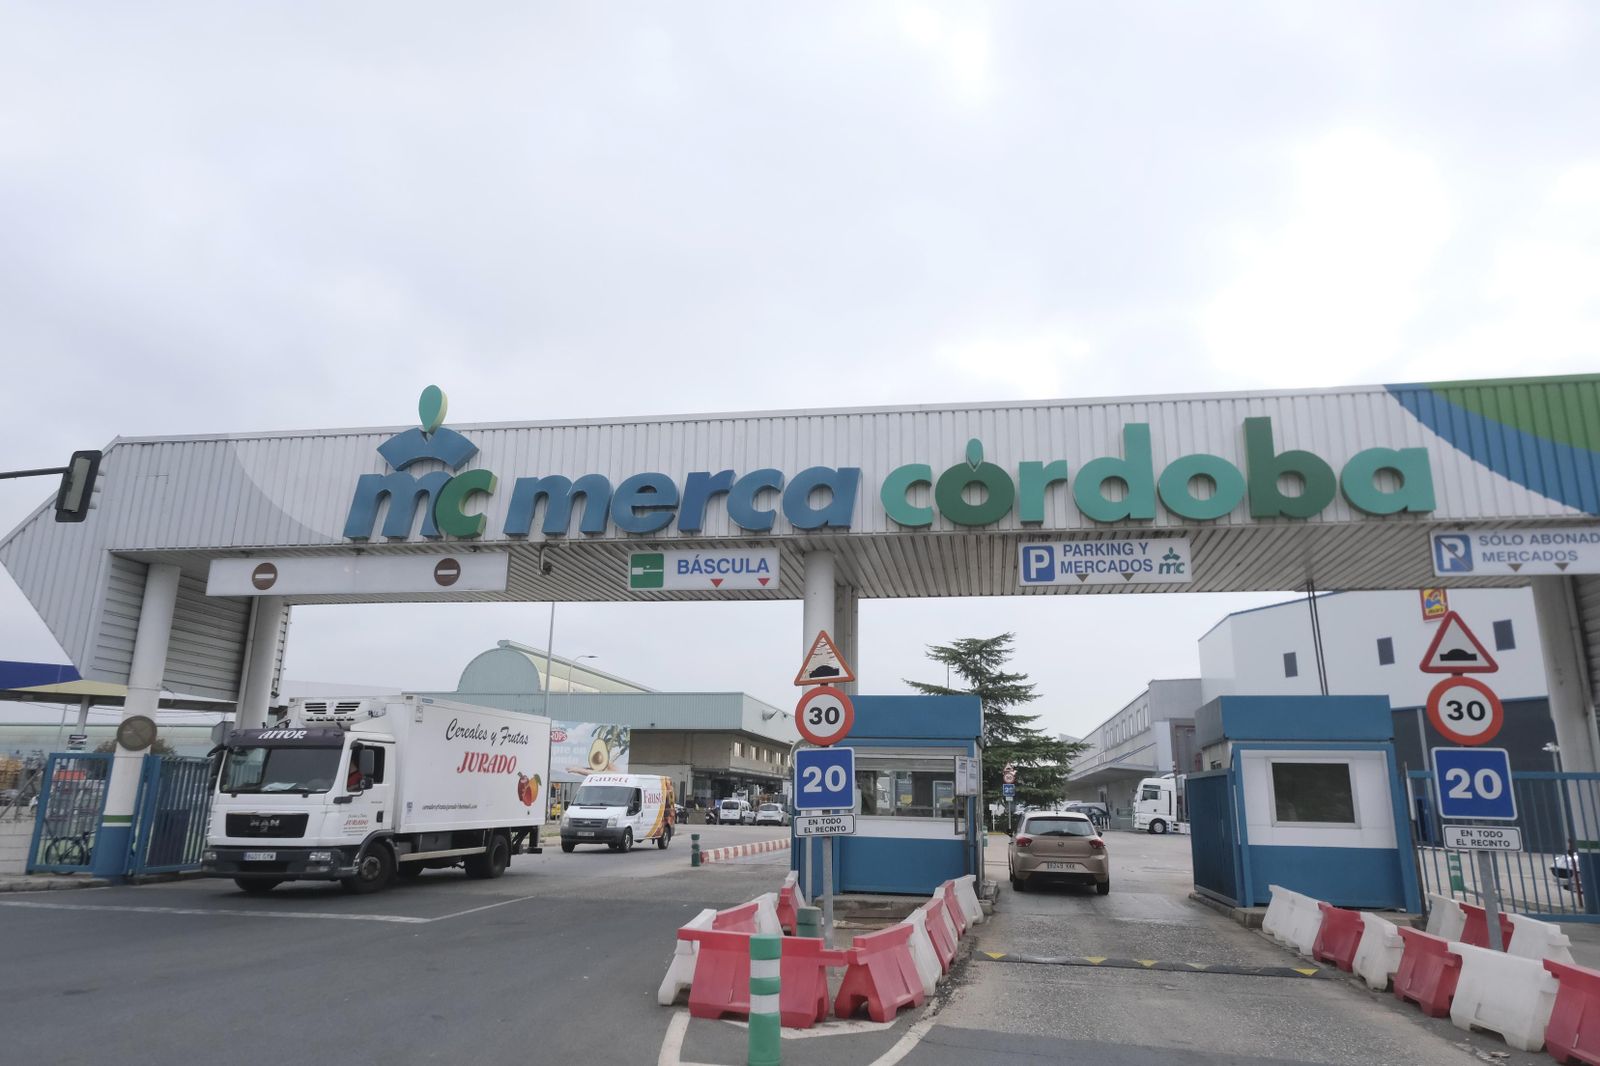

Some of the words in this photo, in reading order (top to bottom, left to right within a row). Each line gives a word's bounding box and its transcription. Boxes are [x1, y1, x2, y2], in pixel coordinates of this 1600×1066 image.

[1478, 531, 1524, 546] SÓLO
[1063, 542, 1134, 557] PARKING
[1138, 542, 1149, 555] Y
[1482, 550, 1579, 563] MERCADOS
[677, 554, 770, 575] BÁSCULA
[1029, 549, 1050, 579] P
[1060, 559, 1153, 574] MERCADOS
[809, 707, 840, 725] 30
[1446, 700, 1486, 721] 30
[258, 730, 307, 739] AITOR
[445, 718, 488, 741] Cereales
[490, 731, 498, 746] y
[500, 726, 529, 746] Frutas
[457, 751, 517, 774] JURADO
[802, 765, 847, 793] 20
[1445, 768, 1503, 800] 20
[808, 818, 819, 826] EN
[821, 817, 842, 825] TODO
[816, 825, 846, 833] RECINTO
[1460, 829, 1474, 838] EN
[1477, 830, 1503, 839] TODO
[1456, 838, 1469, 847] EL
[1471, 839, 1511, 848] RECINTO
